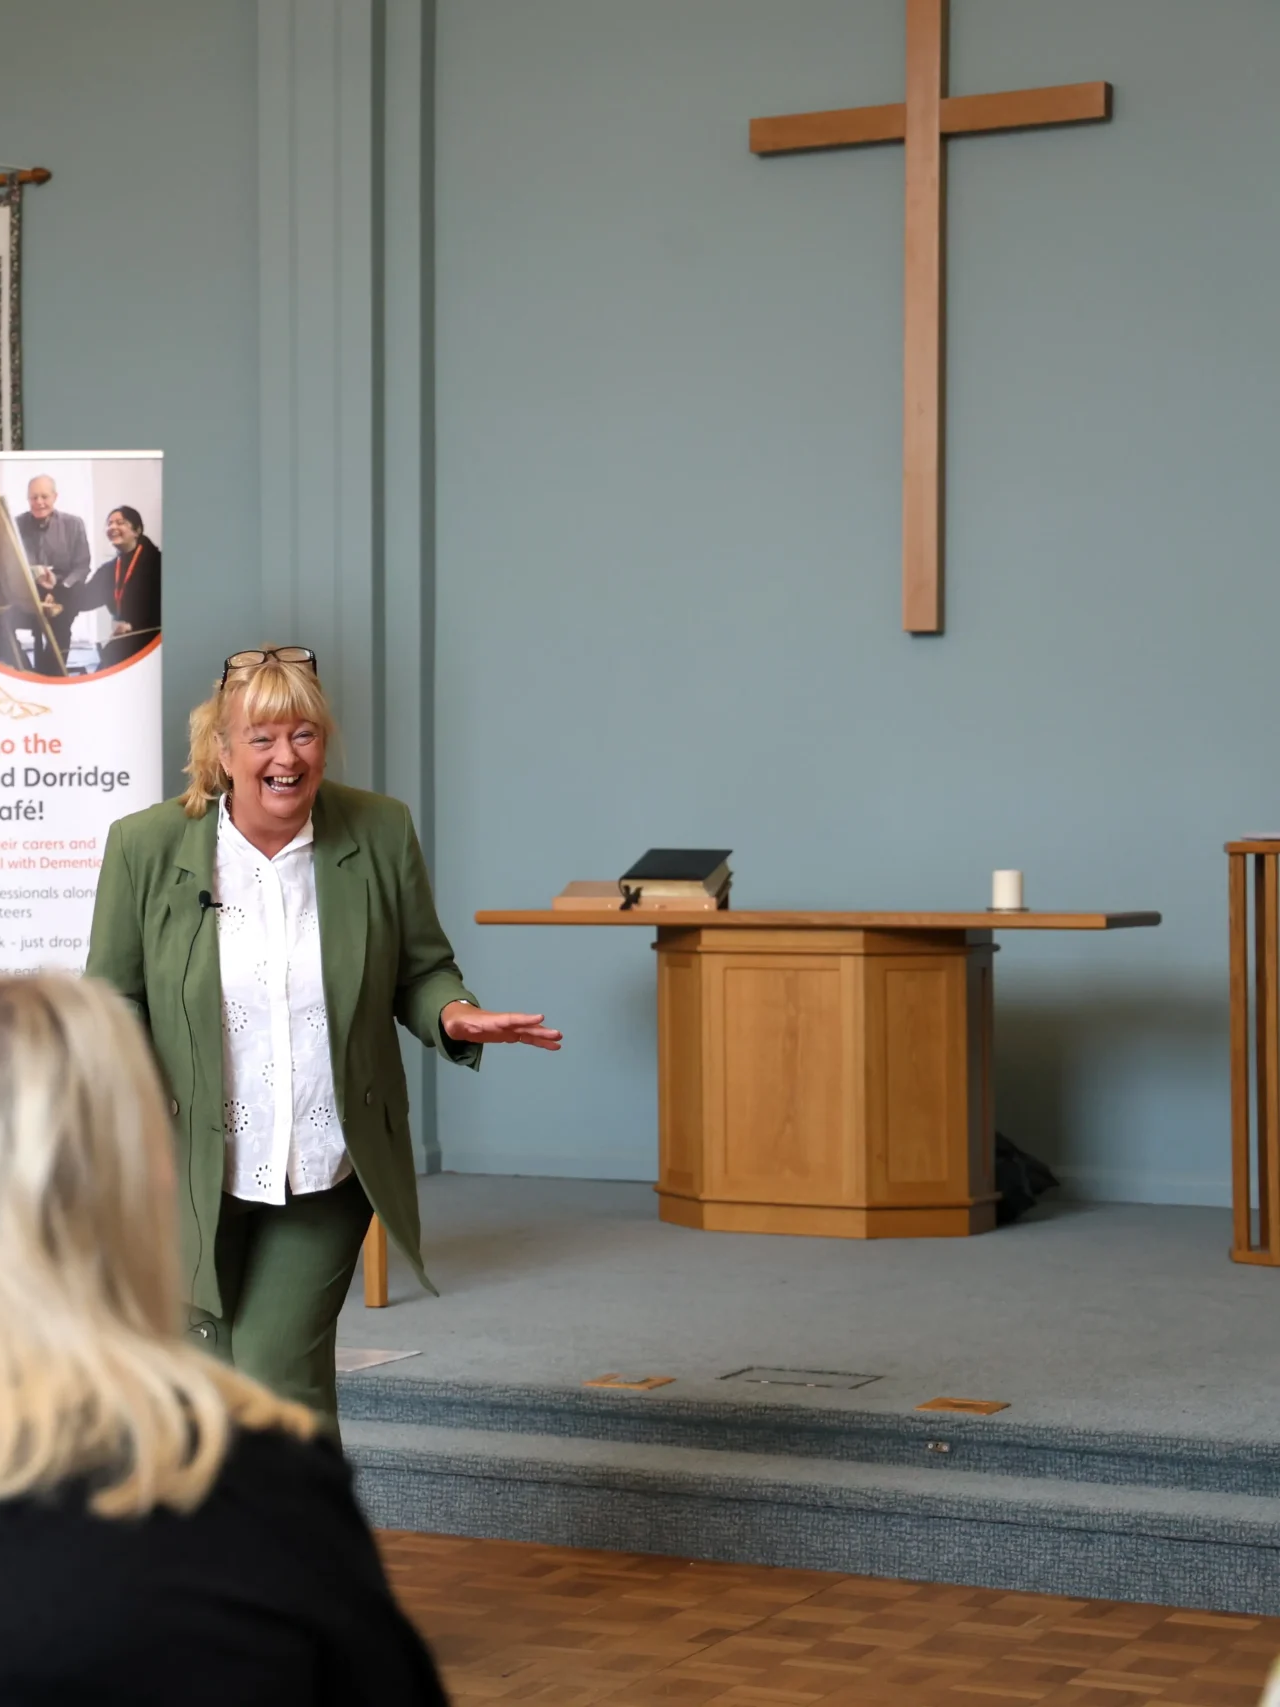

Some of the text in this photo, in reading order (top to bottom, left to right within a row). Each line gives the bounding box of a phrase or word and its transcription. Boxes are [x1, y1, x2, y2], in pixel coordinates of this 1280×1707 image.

[22, 732, 62, 755] the
[23, 766, 131, 793] Dorridge
[22, 838, 65, 851] carers
[68, 837, 97, 851] and
[7, 856, 36, 869] with
[19, 936, 45, 951] just
[49, 935, 83, 951] drop
